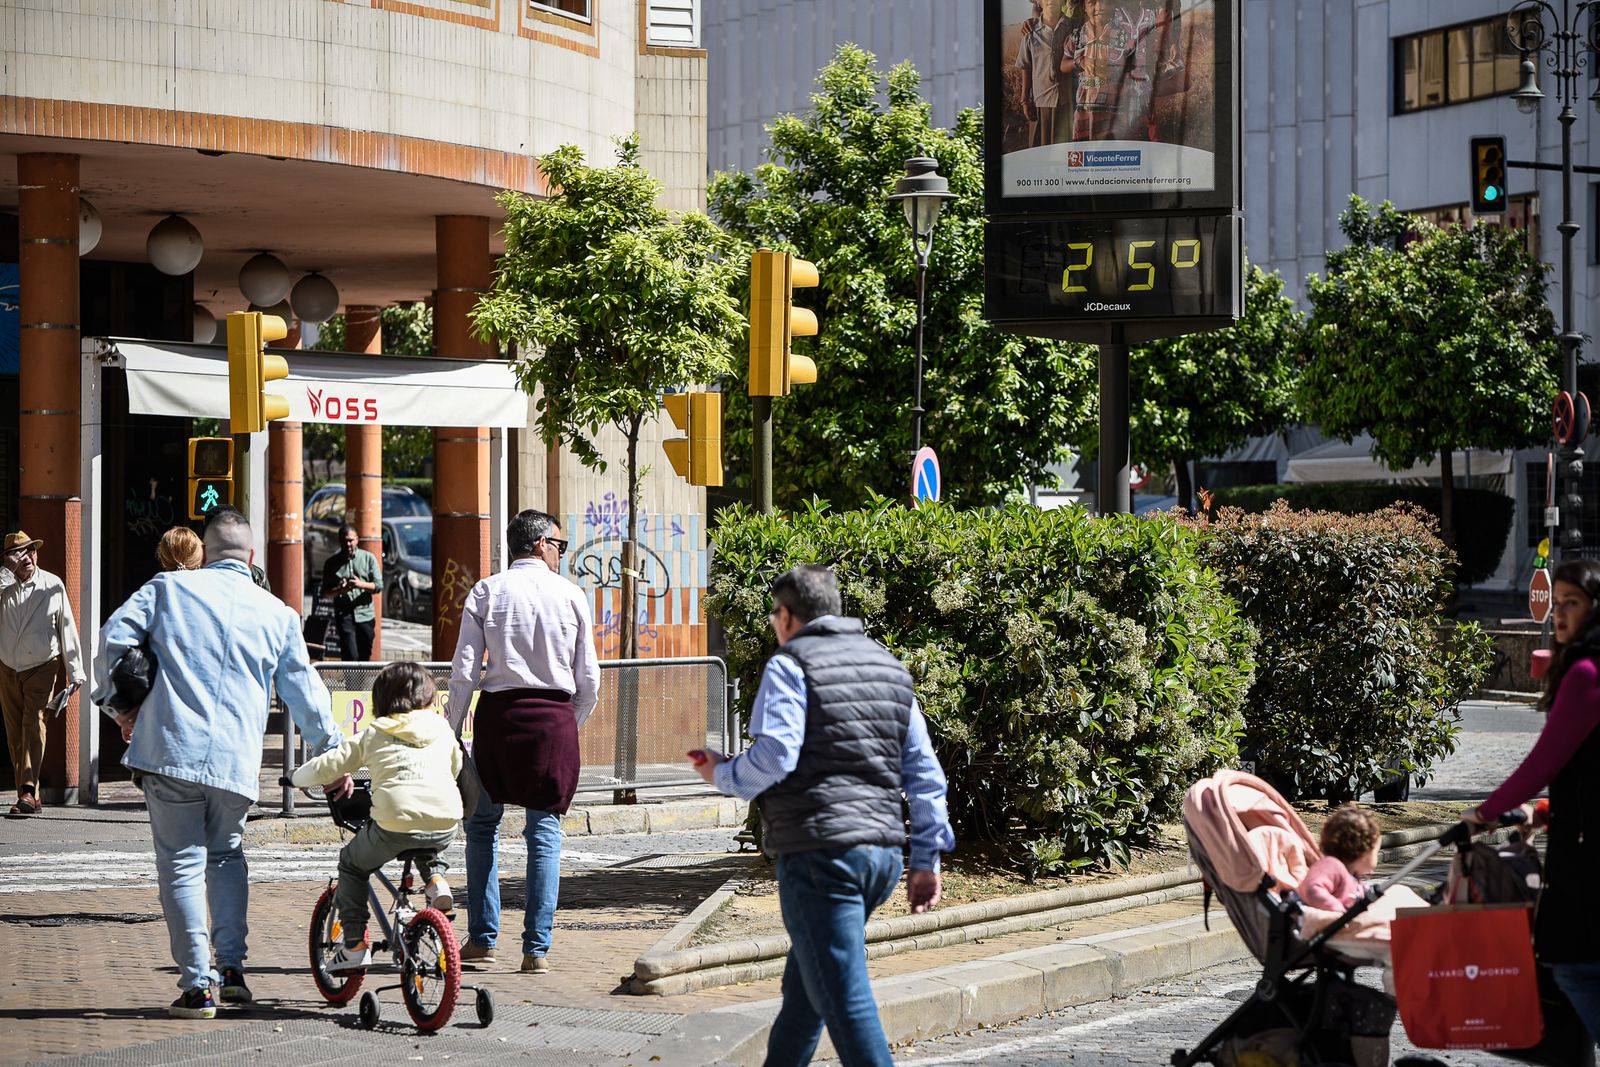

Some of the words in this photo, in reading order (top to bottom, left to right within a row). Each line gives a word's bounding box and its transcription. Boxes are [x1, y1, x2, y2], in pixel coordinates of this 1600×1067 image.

[1086, 154, 1138, 163] VicenteFerrer
[1016, 179, 1031, 187] 900
[1045, 178, 1060, 186] 300
[1065, 176, 1191, 186] www.fundacionvicenteferrer.org
[1083, 302, 1131, 311] JCDecaux
[1531, 590, 1549, 602] STOP
[1428, 969, 1464, 978] ALVARO
[1479, 967, 1519, 976] MORENO
